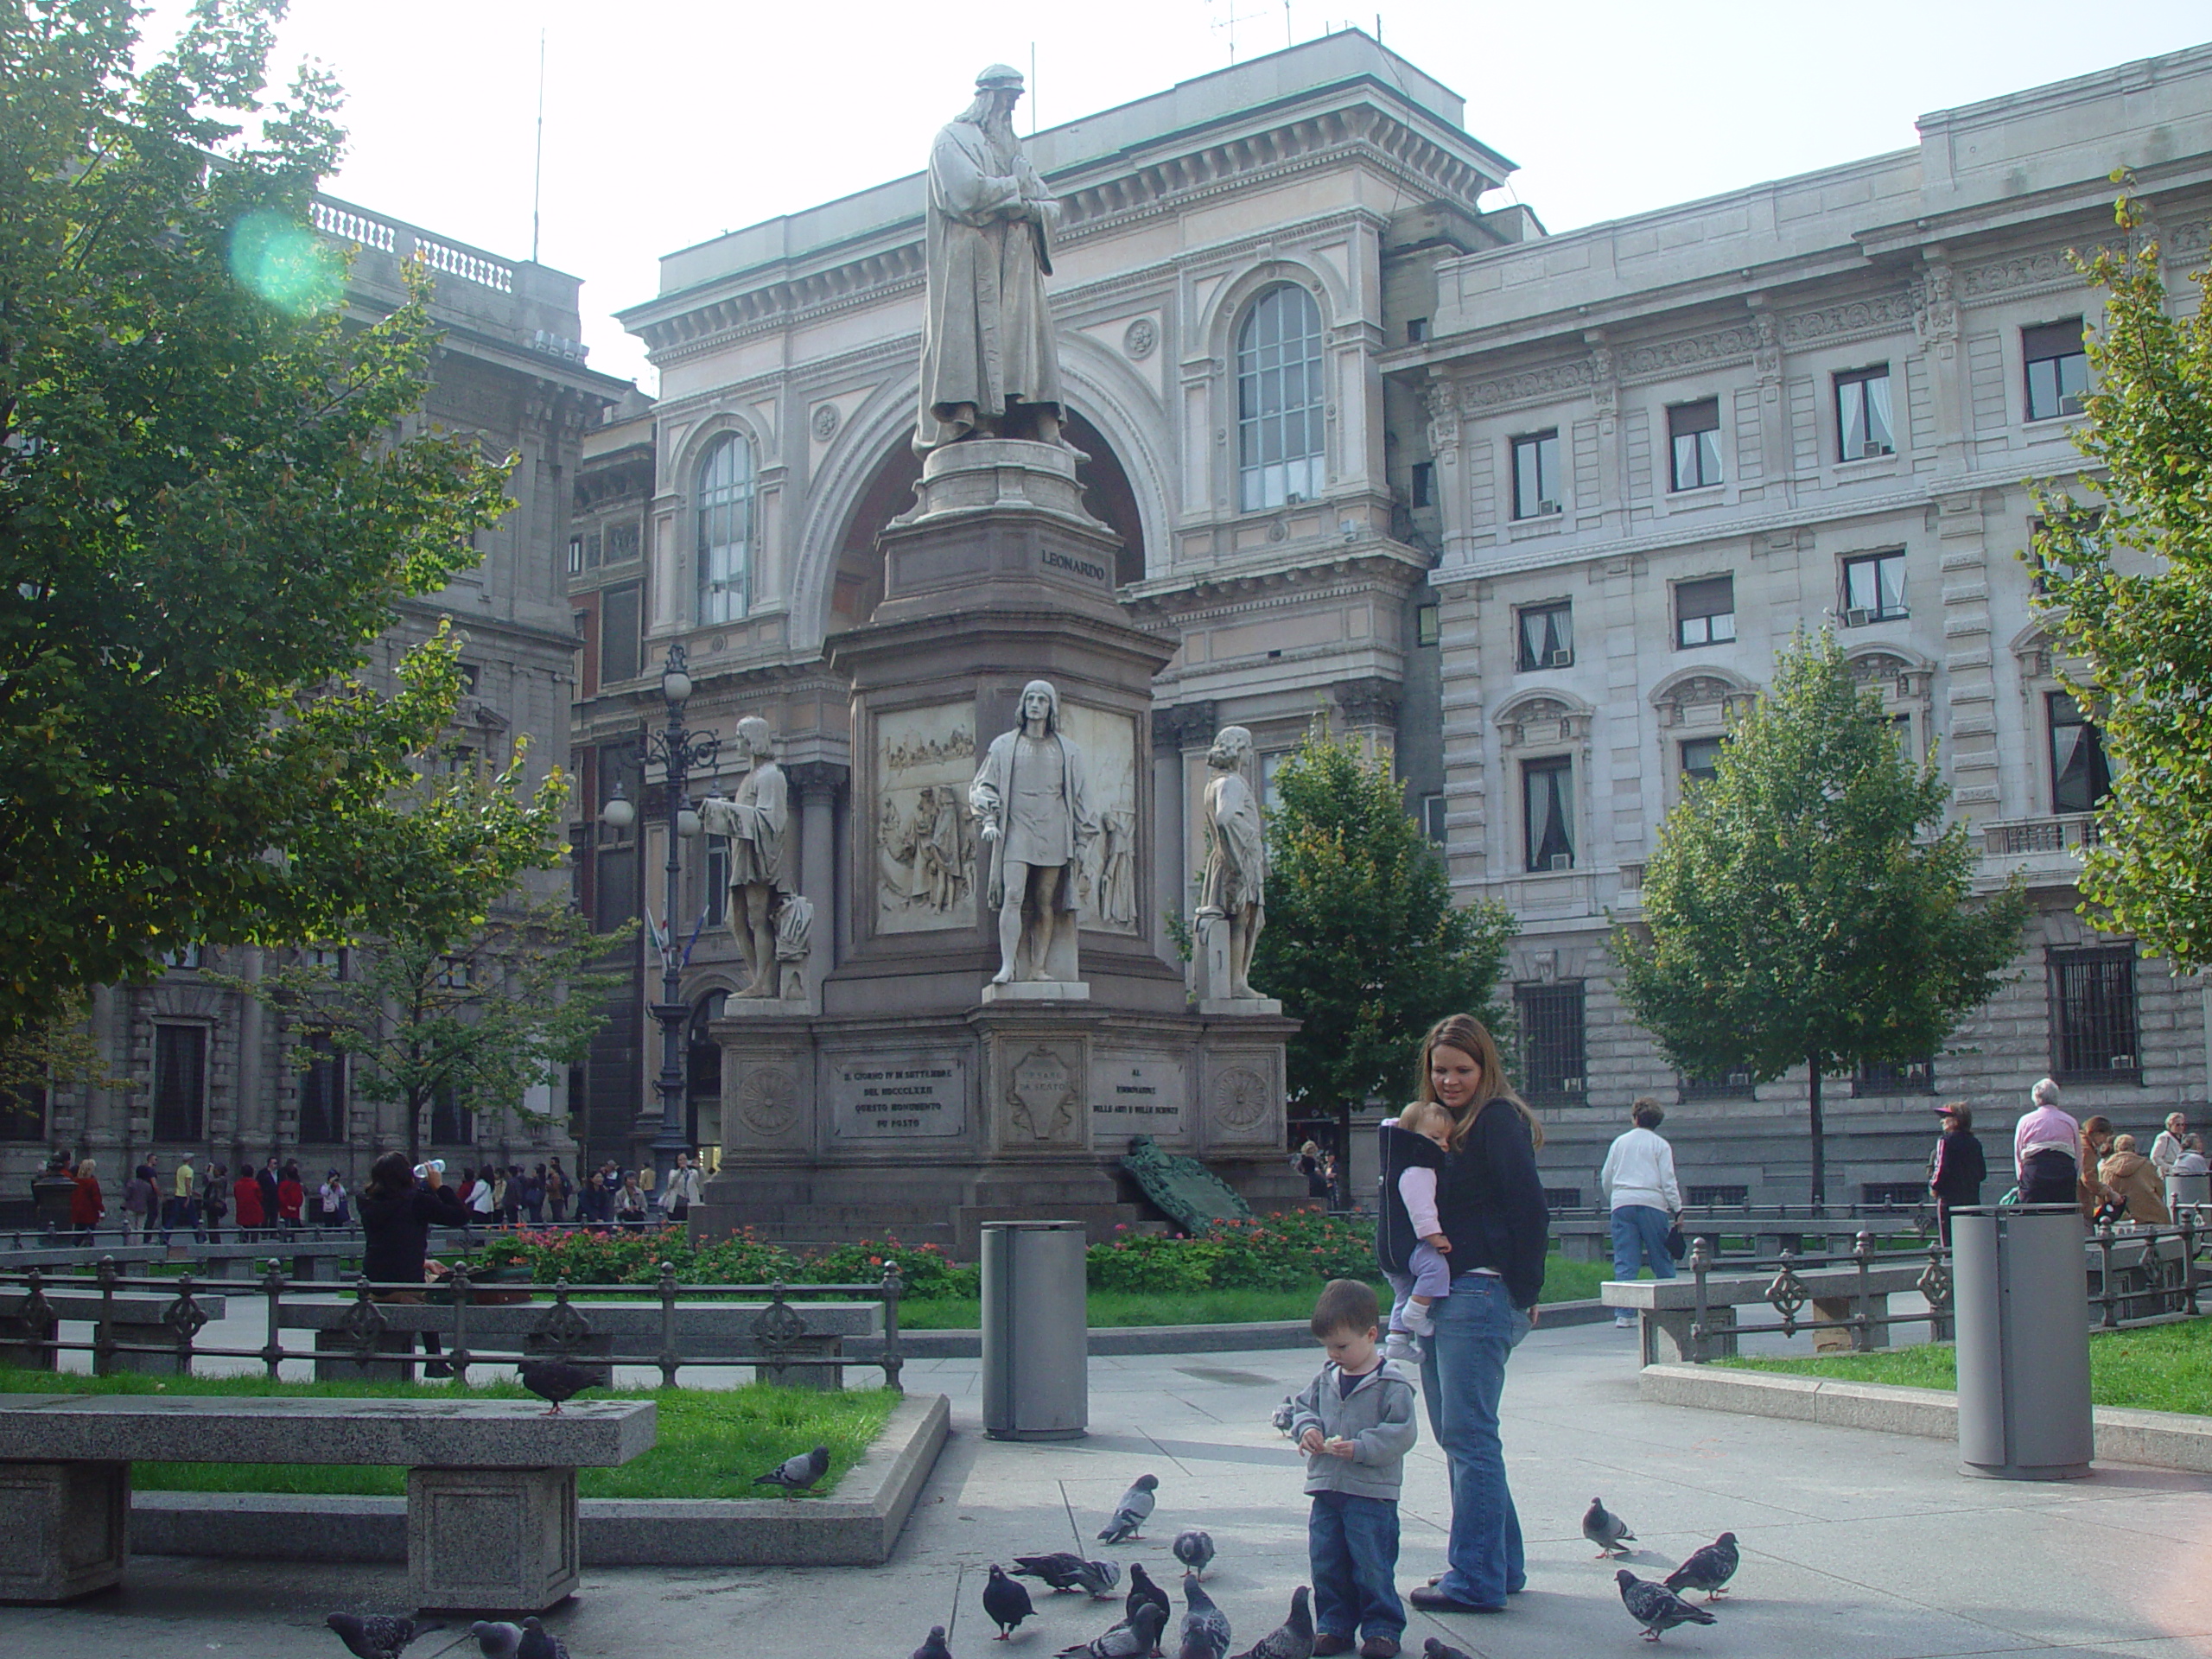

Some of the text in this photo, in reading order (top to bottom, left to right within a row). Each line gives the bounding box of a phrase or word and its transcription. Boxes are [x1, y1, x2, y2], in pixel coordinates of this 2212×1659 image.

[1041, 550, 1105, 581] LEONARDO
[905, 1069, 952, 1079] SETTEMBRE
[863, 1088, 880, 1096] DEL
[855, 1103, 942, 1114] QUESTO MONUMENTO
[876, 1119, 920, 1128] FU POSTO
